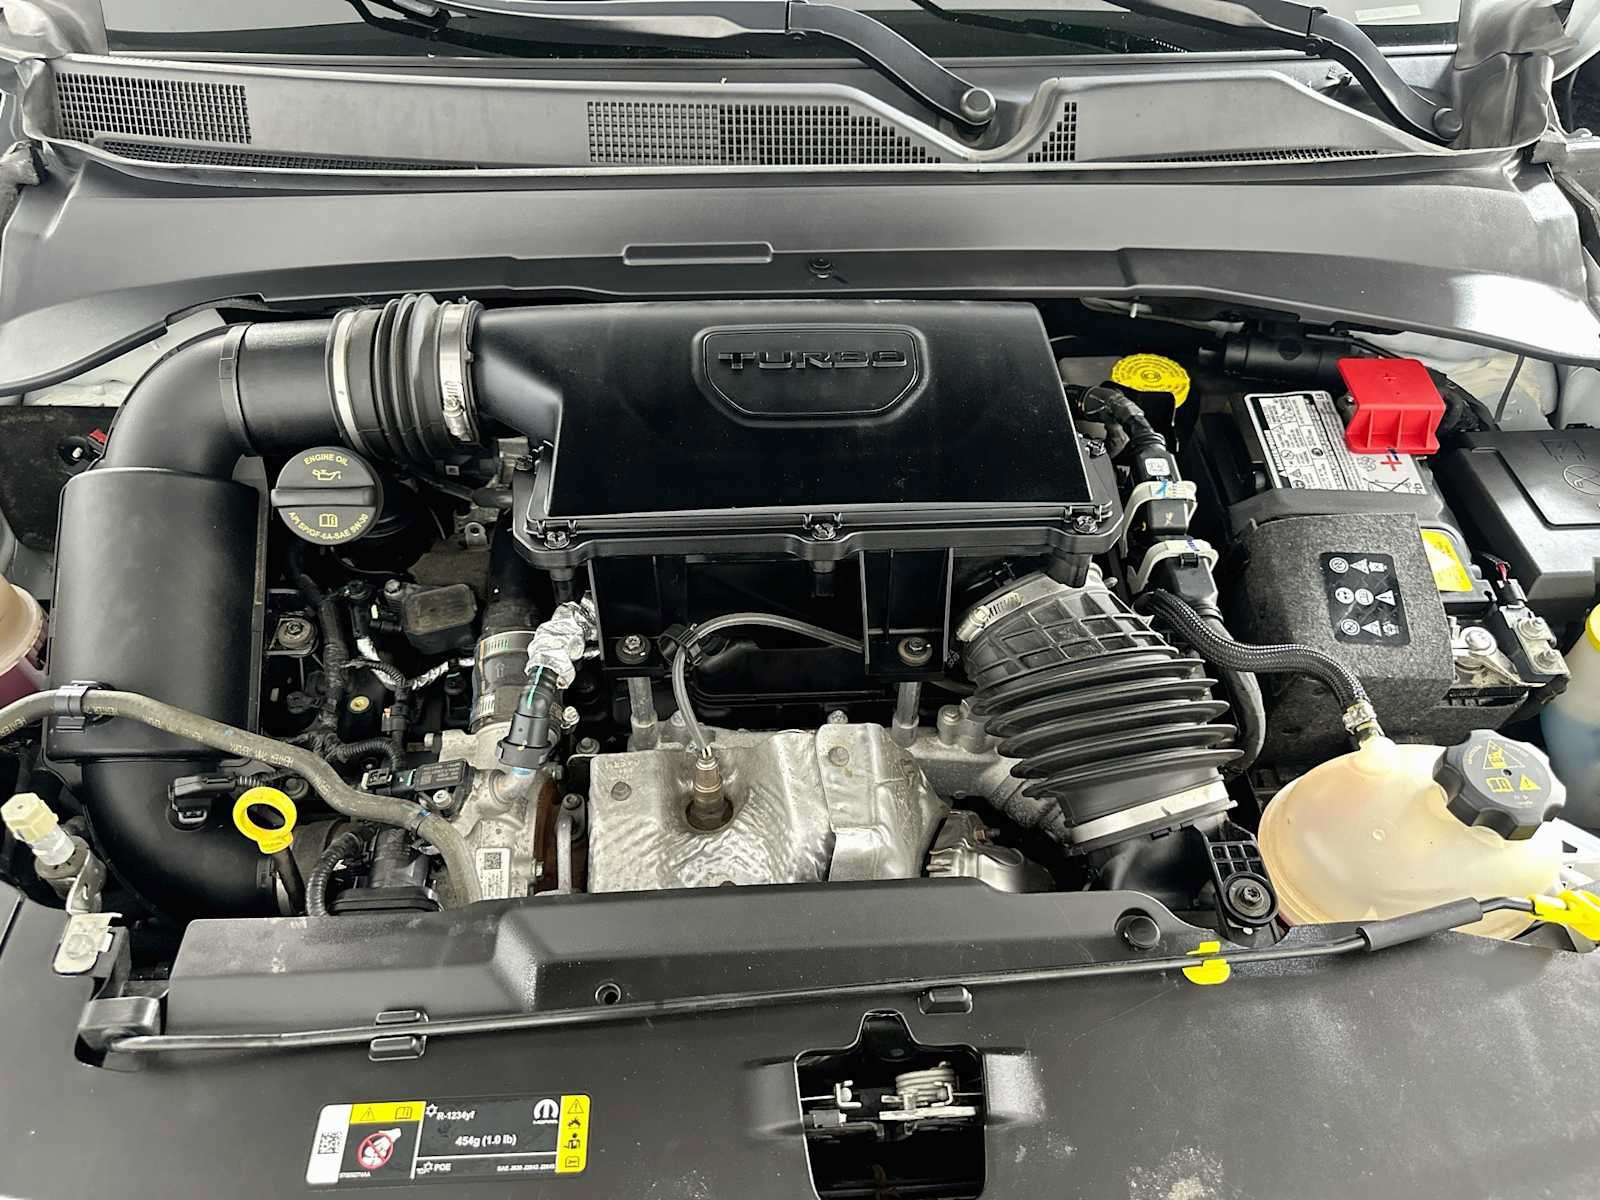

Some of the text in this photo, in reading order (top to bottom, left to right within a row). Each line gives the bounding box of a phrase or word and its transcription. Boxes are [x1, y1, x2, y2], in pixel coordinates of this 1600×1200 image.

[718, 350, 908, 370] TURBO
[304, 453, 348, 466] ENGINE OIL
[288, 511, 300, 525] API
[436, 1110, 475, 1122] R-1234yf
[455, 1134, 517, 1147] 454g (1.0 lb)
